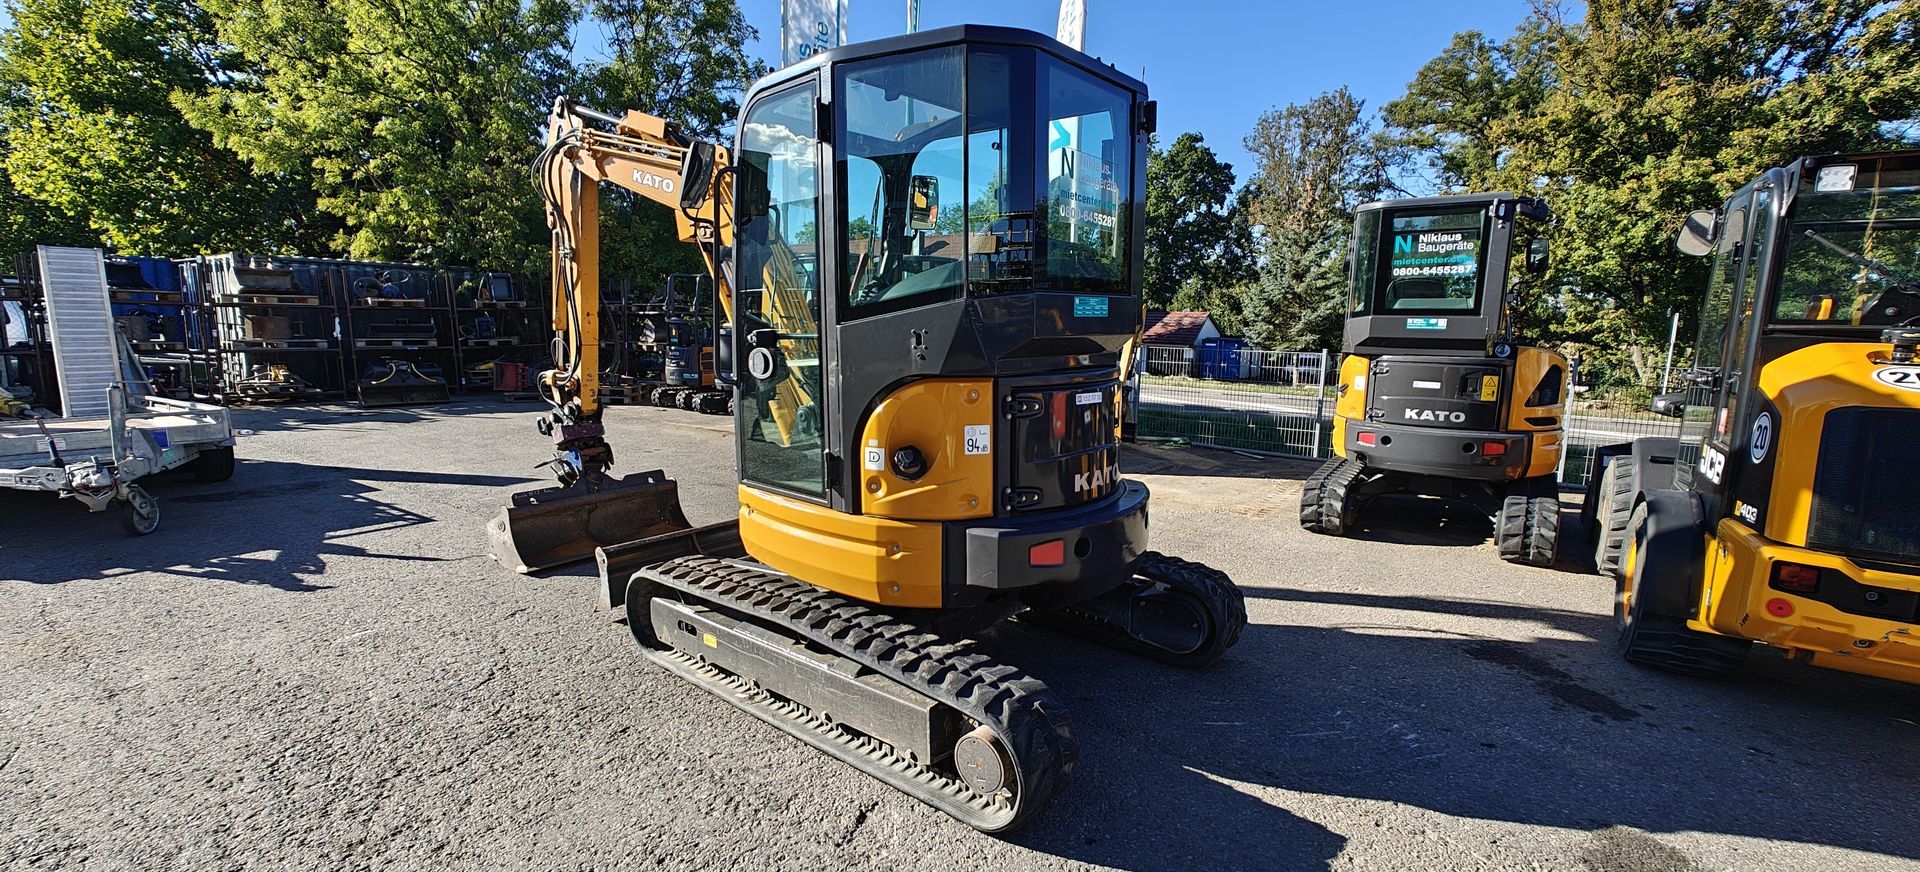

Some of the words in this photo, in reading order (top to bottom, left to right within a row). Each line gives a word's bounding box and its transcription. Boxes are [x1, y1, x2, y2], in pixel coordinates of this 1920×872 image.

[632, 168, 674, 193] KATO
[1418, 232, 1463, 243] Niklaus
[1418, 240, 1475, 253] Baugeräte
[1393, 255, 1473, 266] mietcenter.com
[1393, 264, 1473, 276] 0800-6455287
[1405, 408, 1466, 423] KATO
[1753, 424, 1768, 451] 20
[967, 438, 980, 453] 94
[1701, 444, 1726, 485] JCB
[1074, 462, 1119, 493] KATO
[1740, 503, 1758, 520] 403
